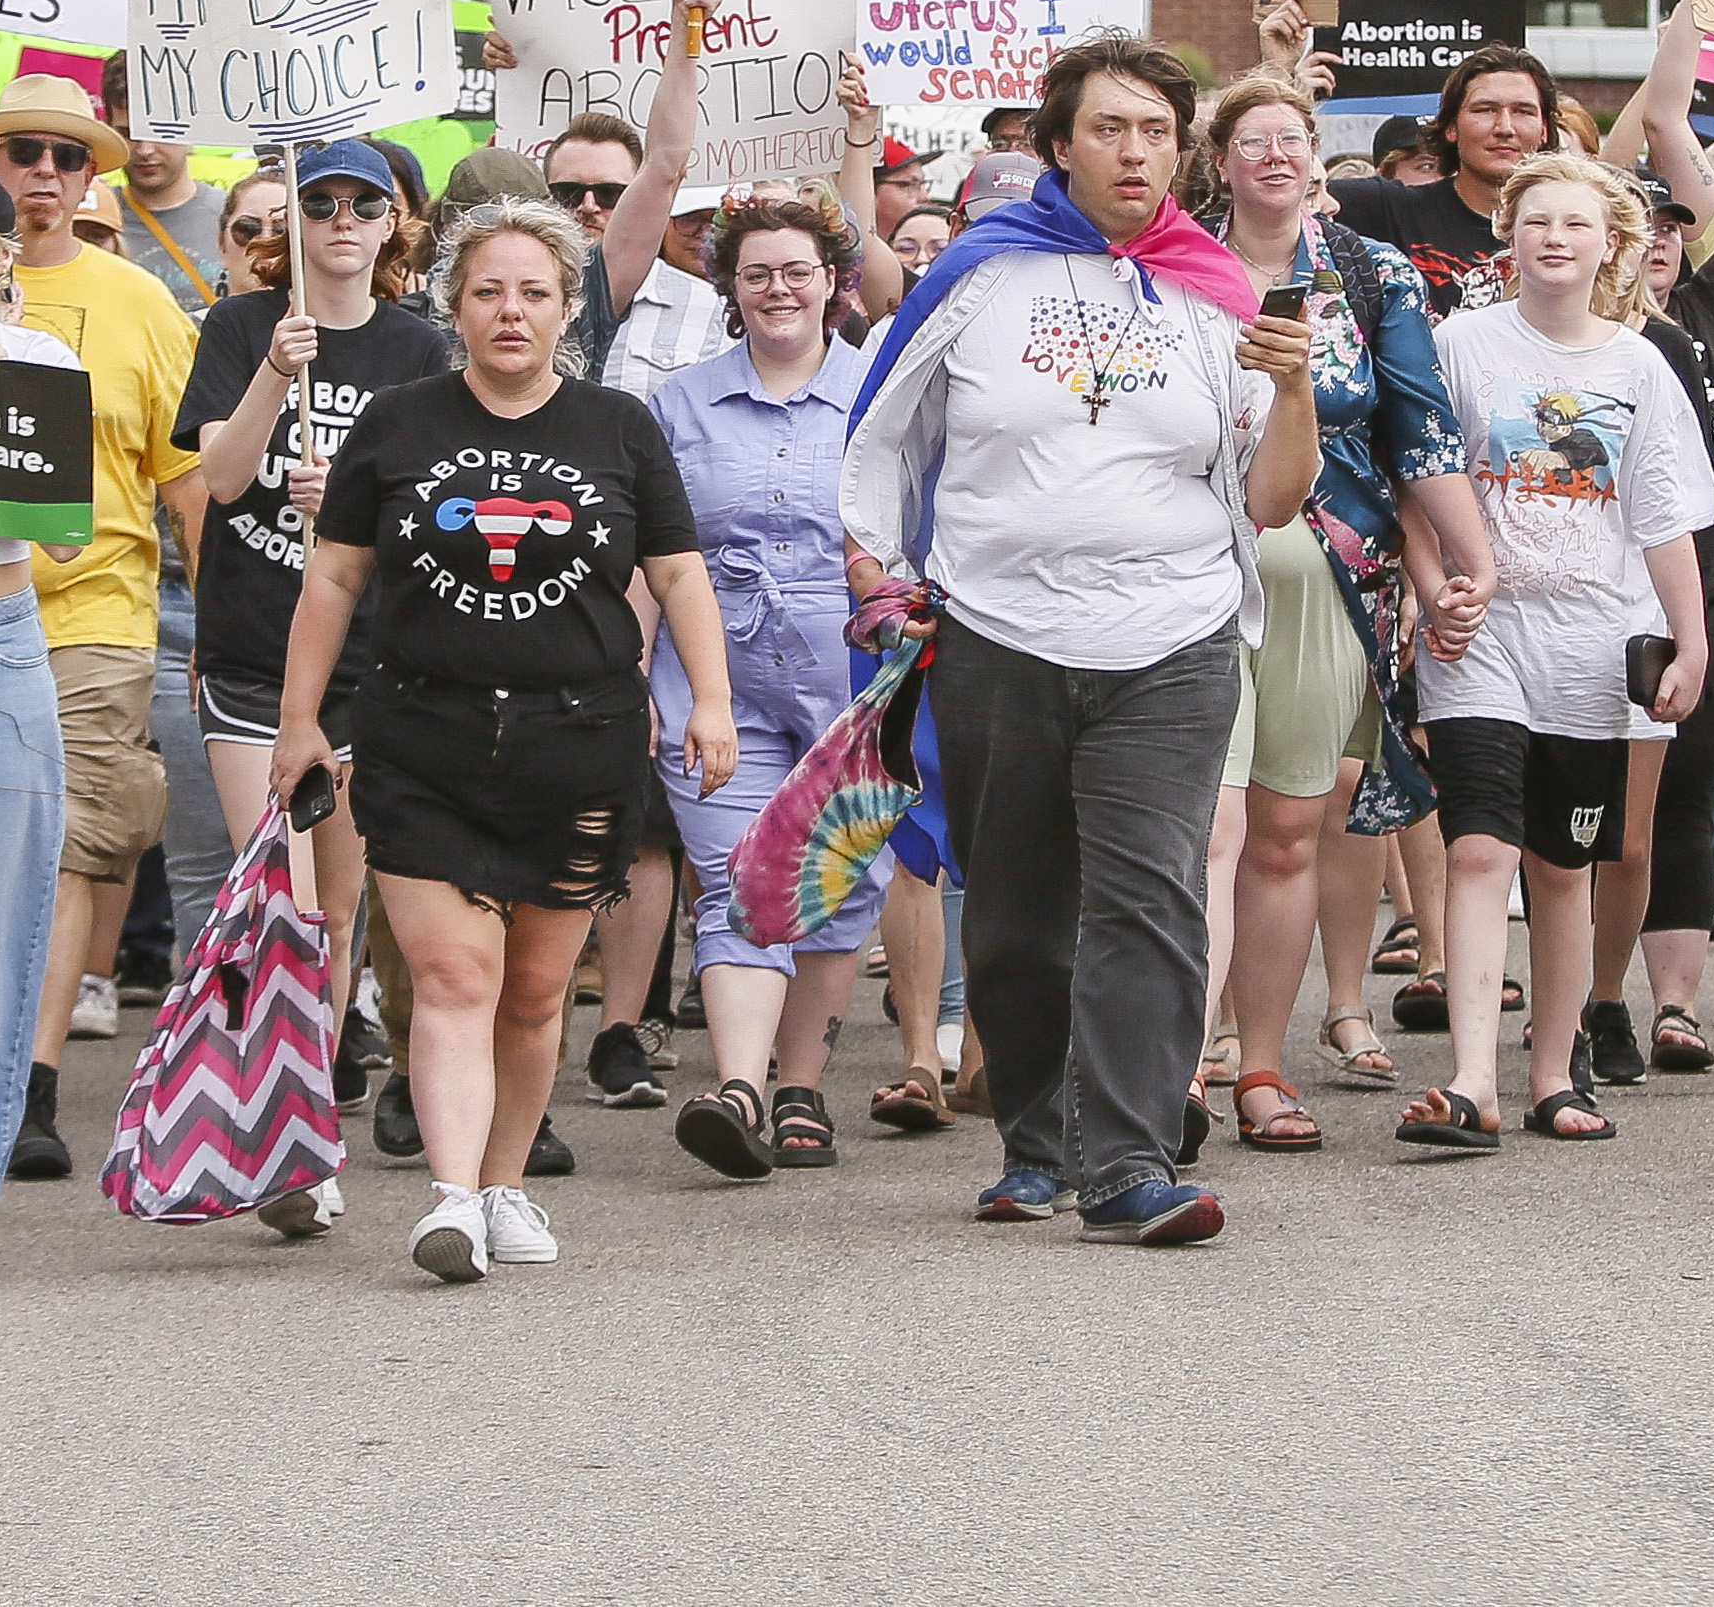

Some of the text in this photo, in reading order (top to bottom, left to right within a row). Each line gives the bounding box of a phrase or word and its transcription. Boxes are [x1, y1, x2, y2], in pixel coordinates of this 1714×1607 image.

[862, 30, 973, 67] would
[1341, 19, 1483, 43] Abortion is
[139, 43, 197, 124] MY
[221, 11, 427, 124] CHOICE!
[1341, 46, 1476, 68] Health Car
[1022, 345, 1087, 393] LOVE
[7, 406, 35, 437] is
[415, 448, 604, 508] ABORTION
[490, 474, 523, 491] IS
[412, 552, 591, 621] FREEDOM
